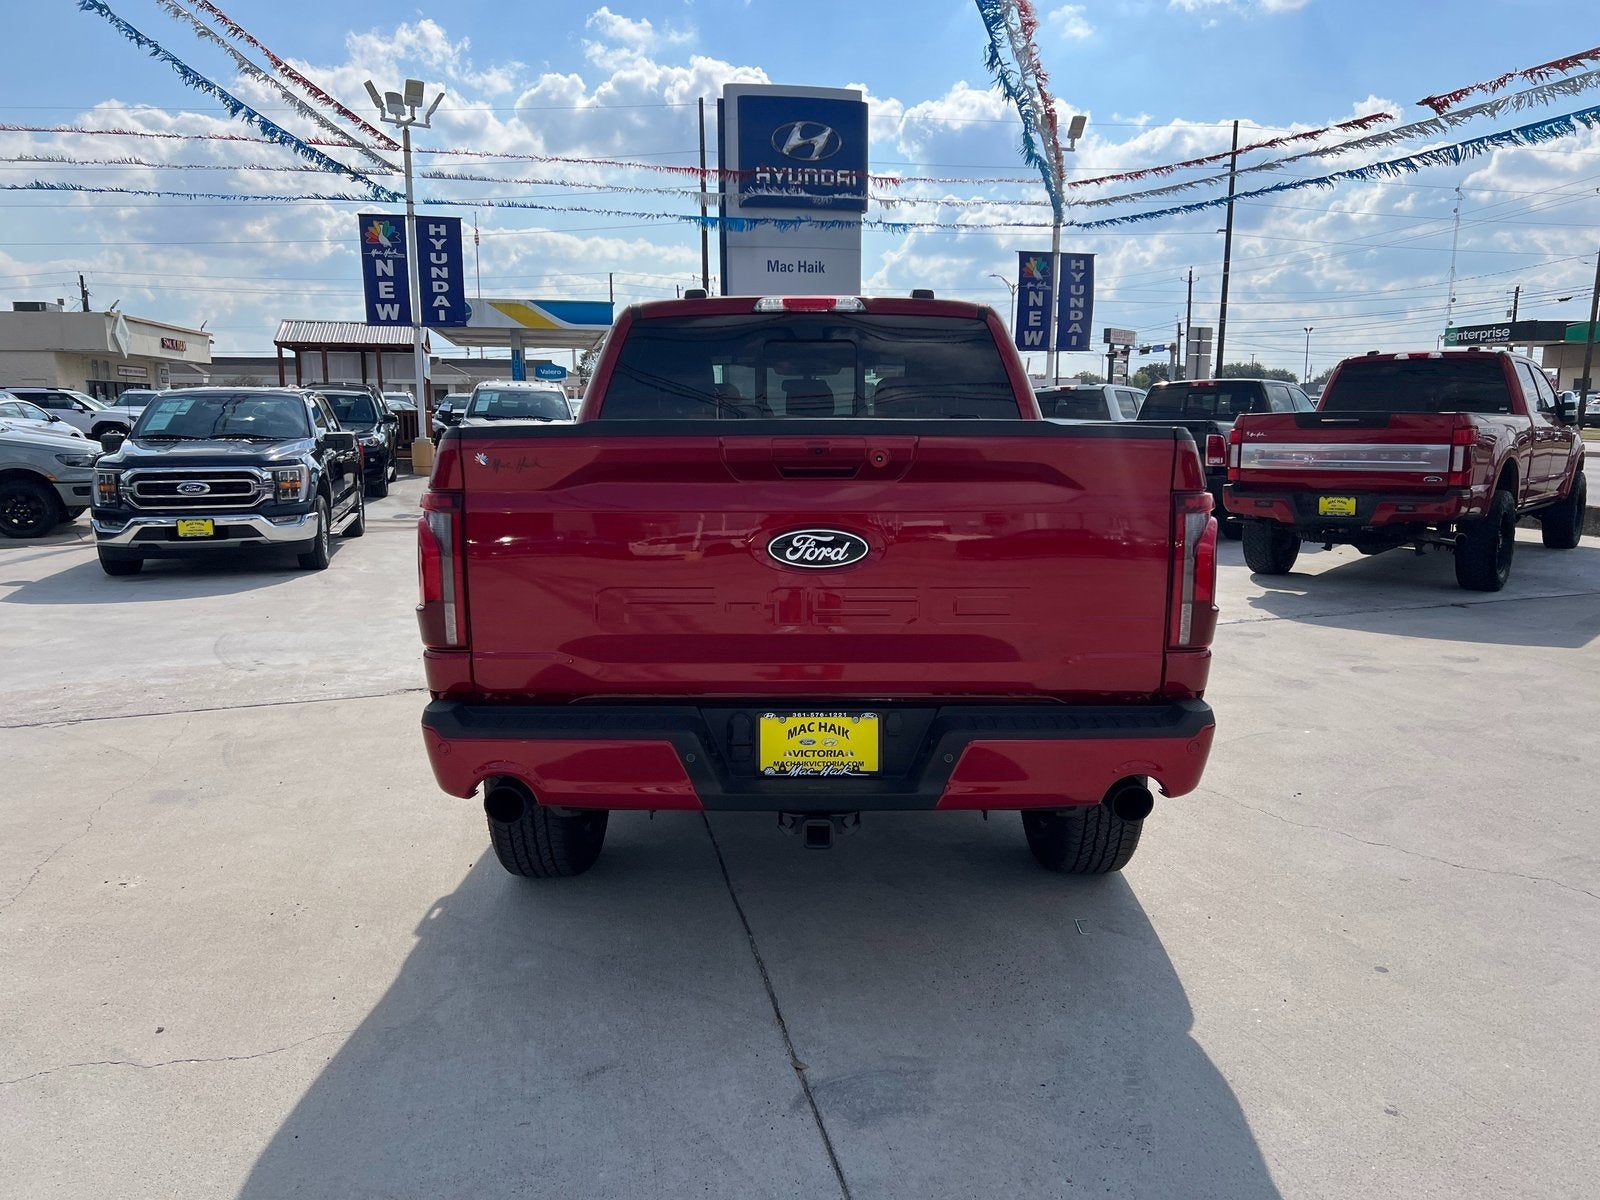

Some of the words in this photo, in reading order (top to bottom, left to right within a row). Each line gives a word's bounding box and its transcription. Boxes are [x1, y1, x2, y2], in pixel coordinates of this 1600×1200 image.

[756, 166, 857, 187] HYUNDAI
[428, 224, 451, 321] HYUNDAI
[767, 260, 794, 273] Mac
[798, 260, 826, 274] Haik
[375, 259, 400, 321] NEW
[1067, 260, 1085, 346] HYUNDAI
[1023, 291, 1044, 346] NEW
[1447, 326, 1510, 342] enterprise
[785, 534, 851, 561] Ford
[787, 722, 815, 740] MAC
[818, 722, 850, 740] HAIK
[792, 749, 845, 758] VICTORIA
[787, 763, 815, 777] Mac
[818, 763, 853, 777] Haik
